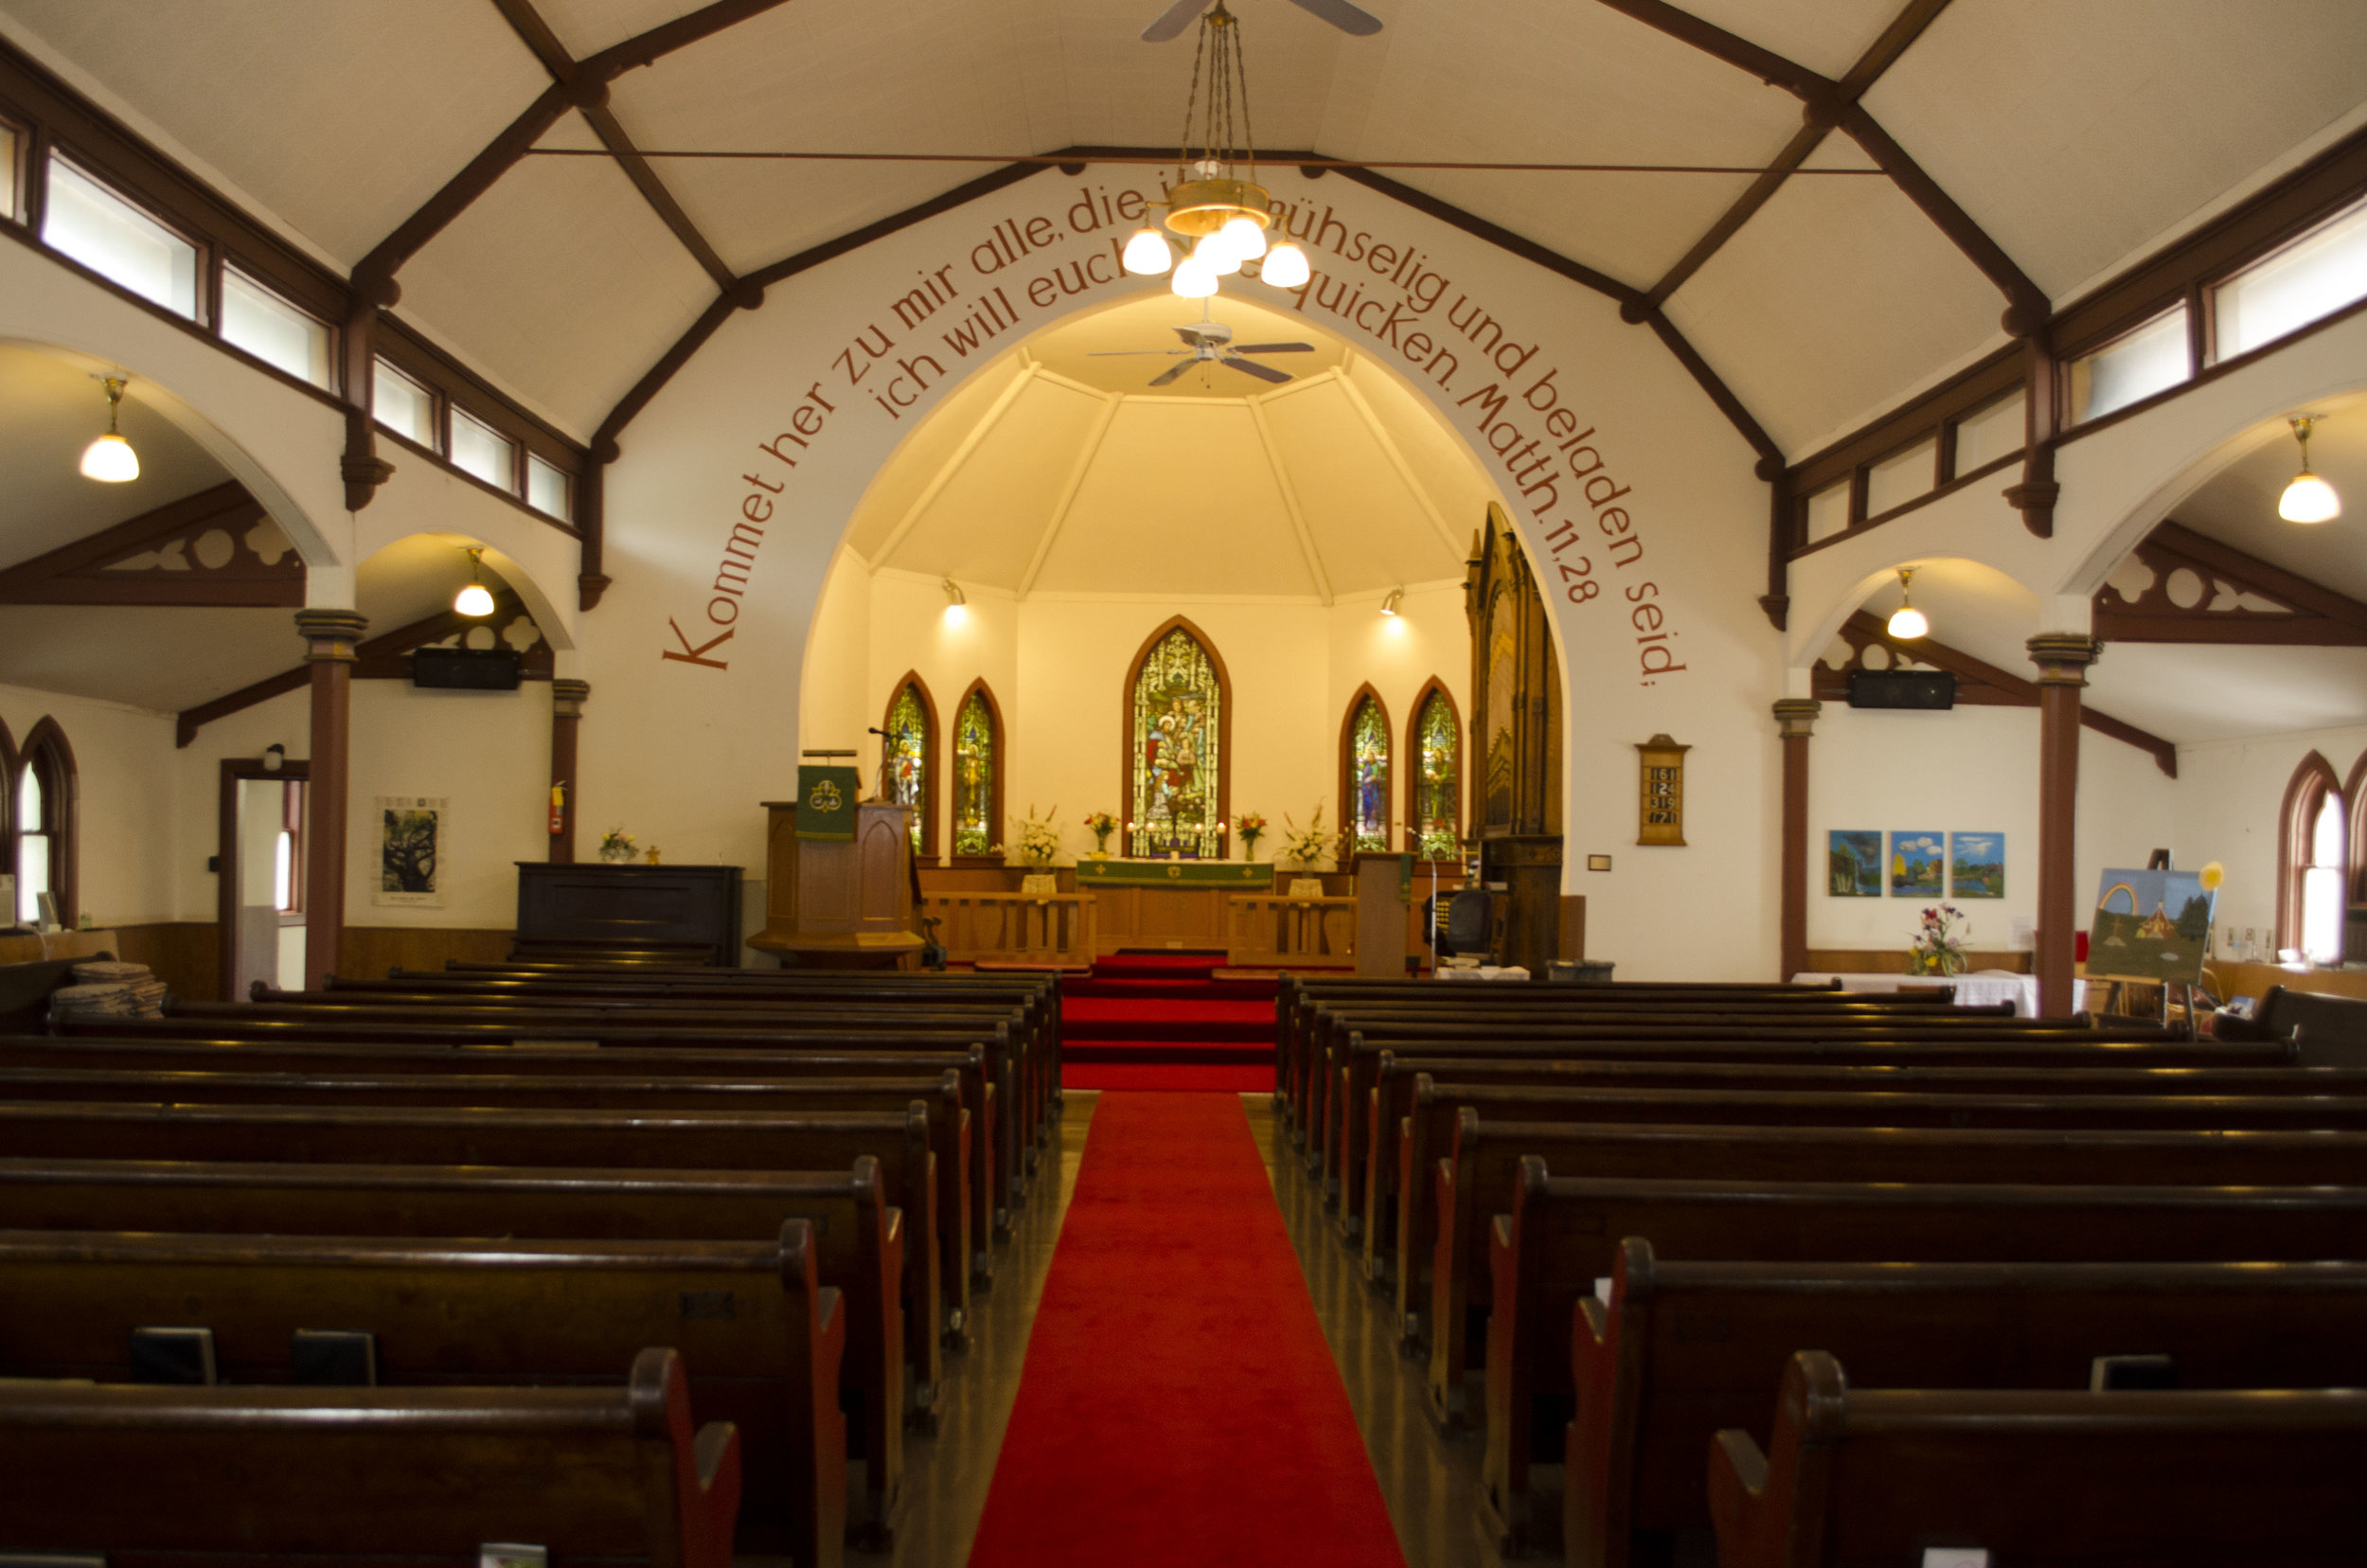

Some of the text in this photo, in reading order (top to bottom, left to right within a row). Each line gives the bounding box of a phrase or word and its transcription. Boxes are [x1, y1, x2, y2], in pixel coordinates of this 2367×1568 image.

[662, 472, 786, 671] Kommet
[758, 382, 836, 469] her
[831, 323, 897, 386] zu
[890, 264, 959, 331] mir
[970, 216, 1064, 275] alle,
[1067, 186, 1149, 234] die
[1448, 294, 1540, 380] und
[1522, 366, 1644, 569] beladen
[1625, 581, 1687, 687] seid;
[867, 354, 948, 420] ich
[941, 287, 1022, 358] will
[1456, 383, 1560, 524] Matth.
[1545, 519, 1600, 604] 11,28
